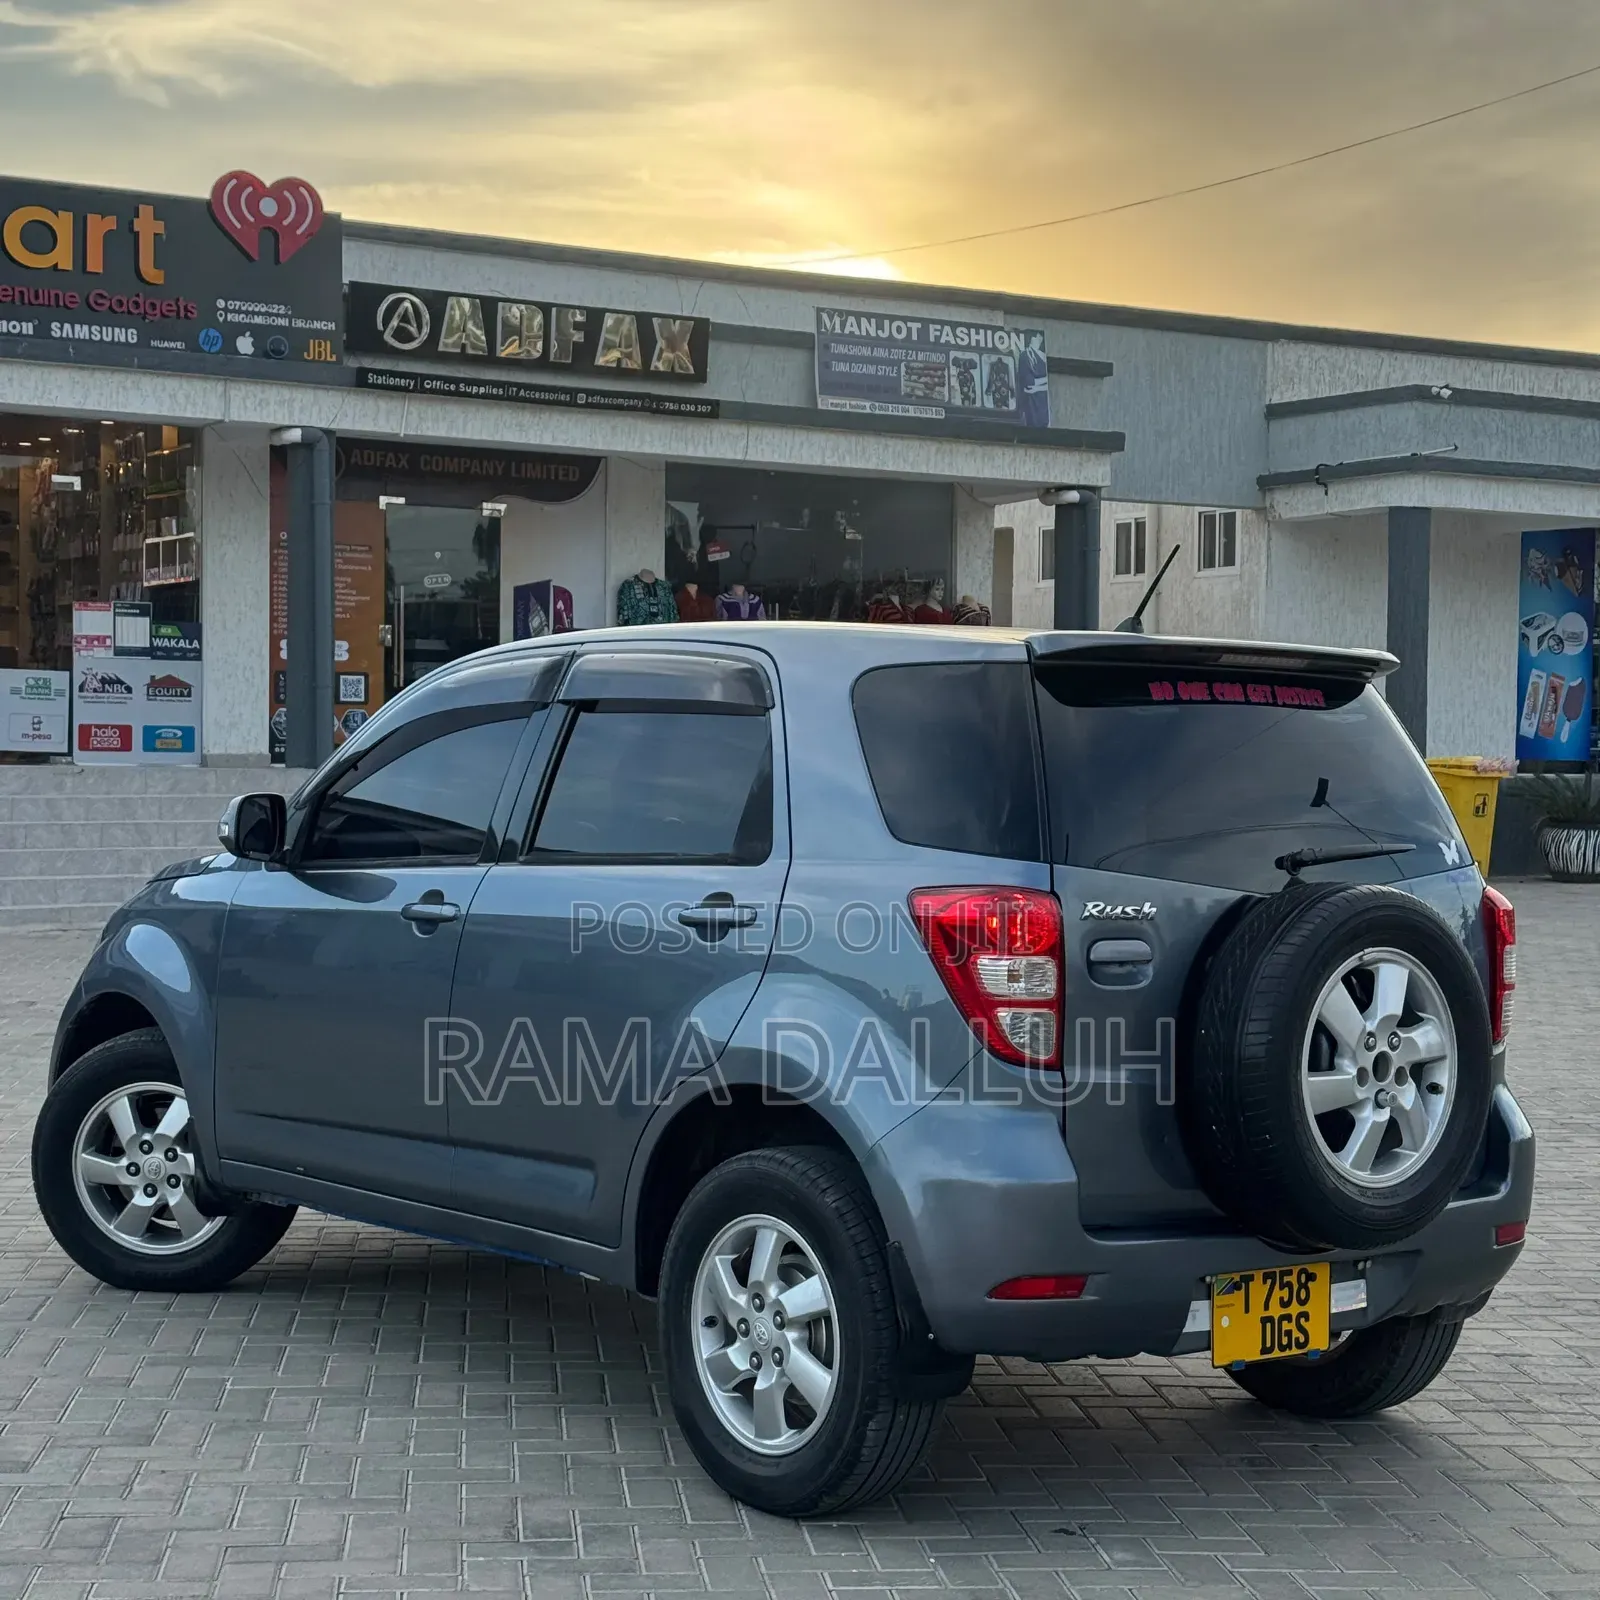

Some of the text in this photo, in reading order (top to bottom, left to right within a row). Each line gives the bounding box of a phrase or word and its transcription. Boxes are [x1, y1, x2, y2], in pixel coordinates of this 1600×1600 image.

[3, 203, 165, 285] art
[88, 288, 198, 322] Gadgets
[50, 320, 138, 344] SAMSUNG
[291, 318, 336, 331] BRANCH
[820, 308, 1026, 350] MANJOT FASHION
[150, 339, 186, 350] HUAWEI
[437, 296, 696, 375] ADFAX
[303, 338, 337, 362] JBL
[830, 343, 947, 363] TUNASHONA AINA ZOTE ZA MITINDO
[831, 361, 899, 377] TUNA DIZAINI STYLE
[367, 372, 416, 390] Stationery
[423, 379, 456, 391] Office
[459, 383, 504, 396] Supplies
[508, 387, 518, 396] IT
[518, 388, 571, 402] Accessories
[696, 405, 712, 413] 307
[351, 448, 581, 483] ADFAX COMPANY LIMITED
[426, 576, 449, 585] OPEN
[152, 638, 200, 649] WAKALA
[26, 687, 51, 695] BANK
[104, 683, 129, 694] NBC
[148, 687, 189, 697] EQUITY
[1148, 681, 1174, 700] NO
[1246, 683, 1273, 704] GET
[21, 733, 52, 742] m-pesa
[91, 725, 120, 738] halo
[90, 737, 120, 749] pesa
[1080, 901, 1157, 921] Rush
[1240, 1267, 1312, 1314] T 758
[1260, 1311, 1310, 1356] DGS
